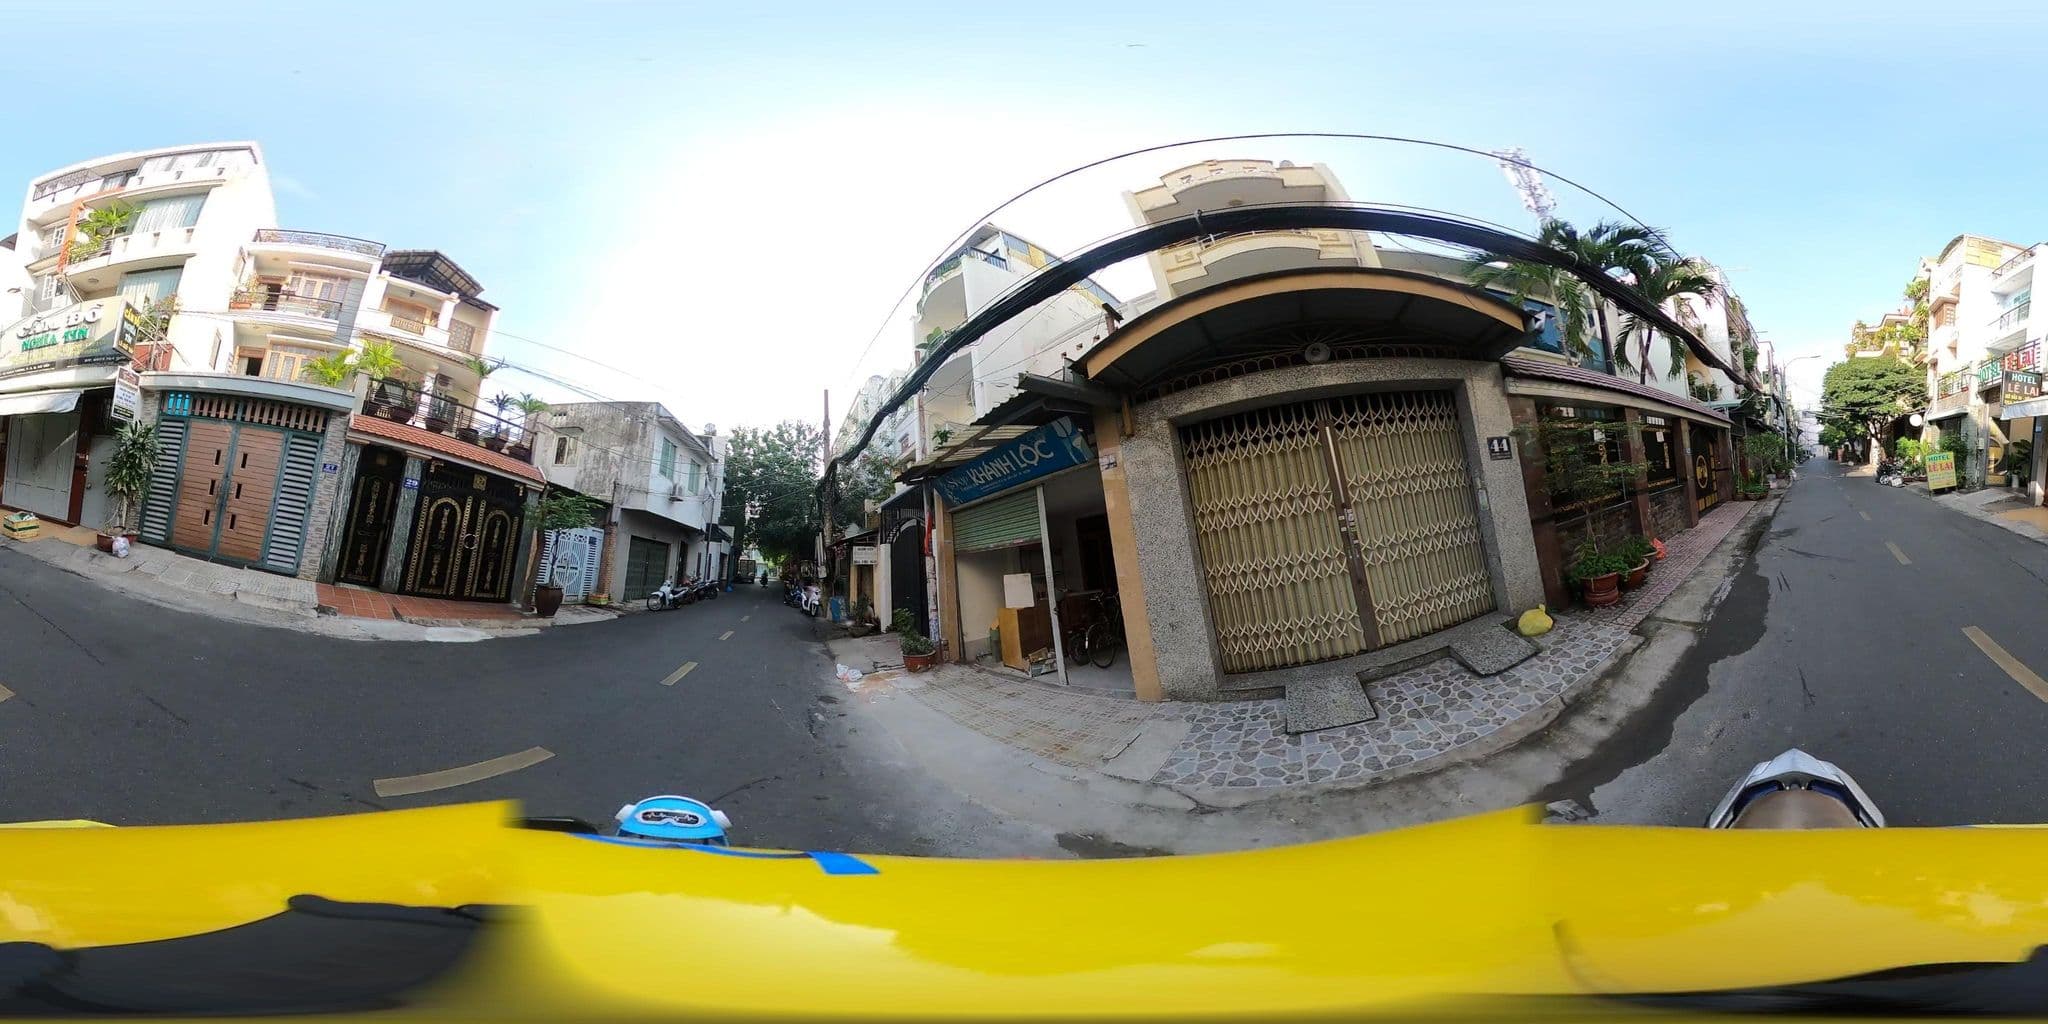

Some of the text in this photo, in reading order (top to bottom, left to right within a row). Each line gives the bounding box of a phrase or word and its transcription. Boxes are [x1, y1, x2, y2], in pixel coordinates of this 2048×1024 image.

[2011, 373, 2038, 385] HOTEL
[2023, 385, 2040, 397] LAI
[1490, 438, 1509, 452] 44
[1928, 453, 1951, 461] HOTEL
[966, 453, 1017, 486] KHÁNH
